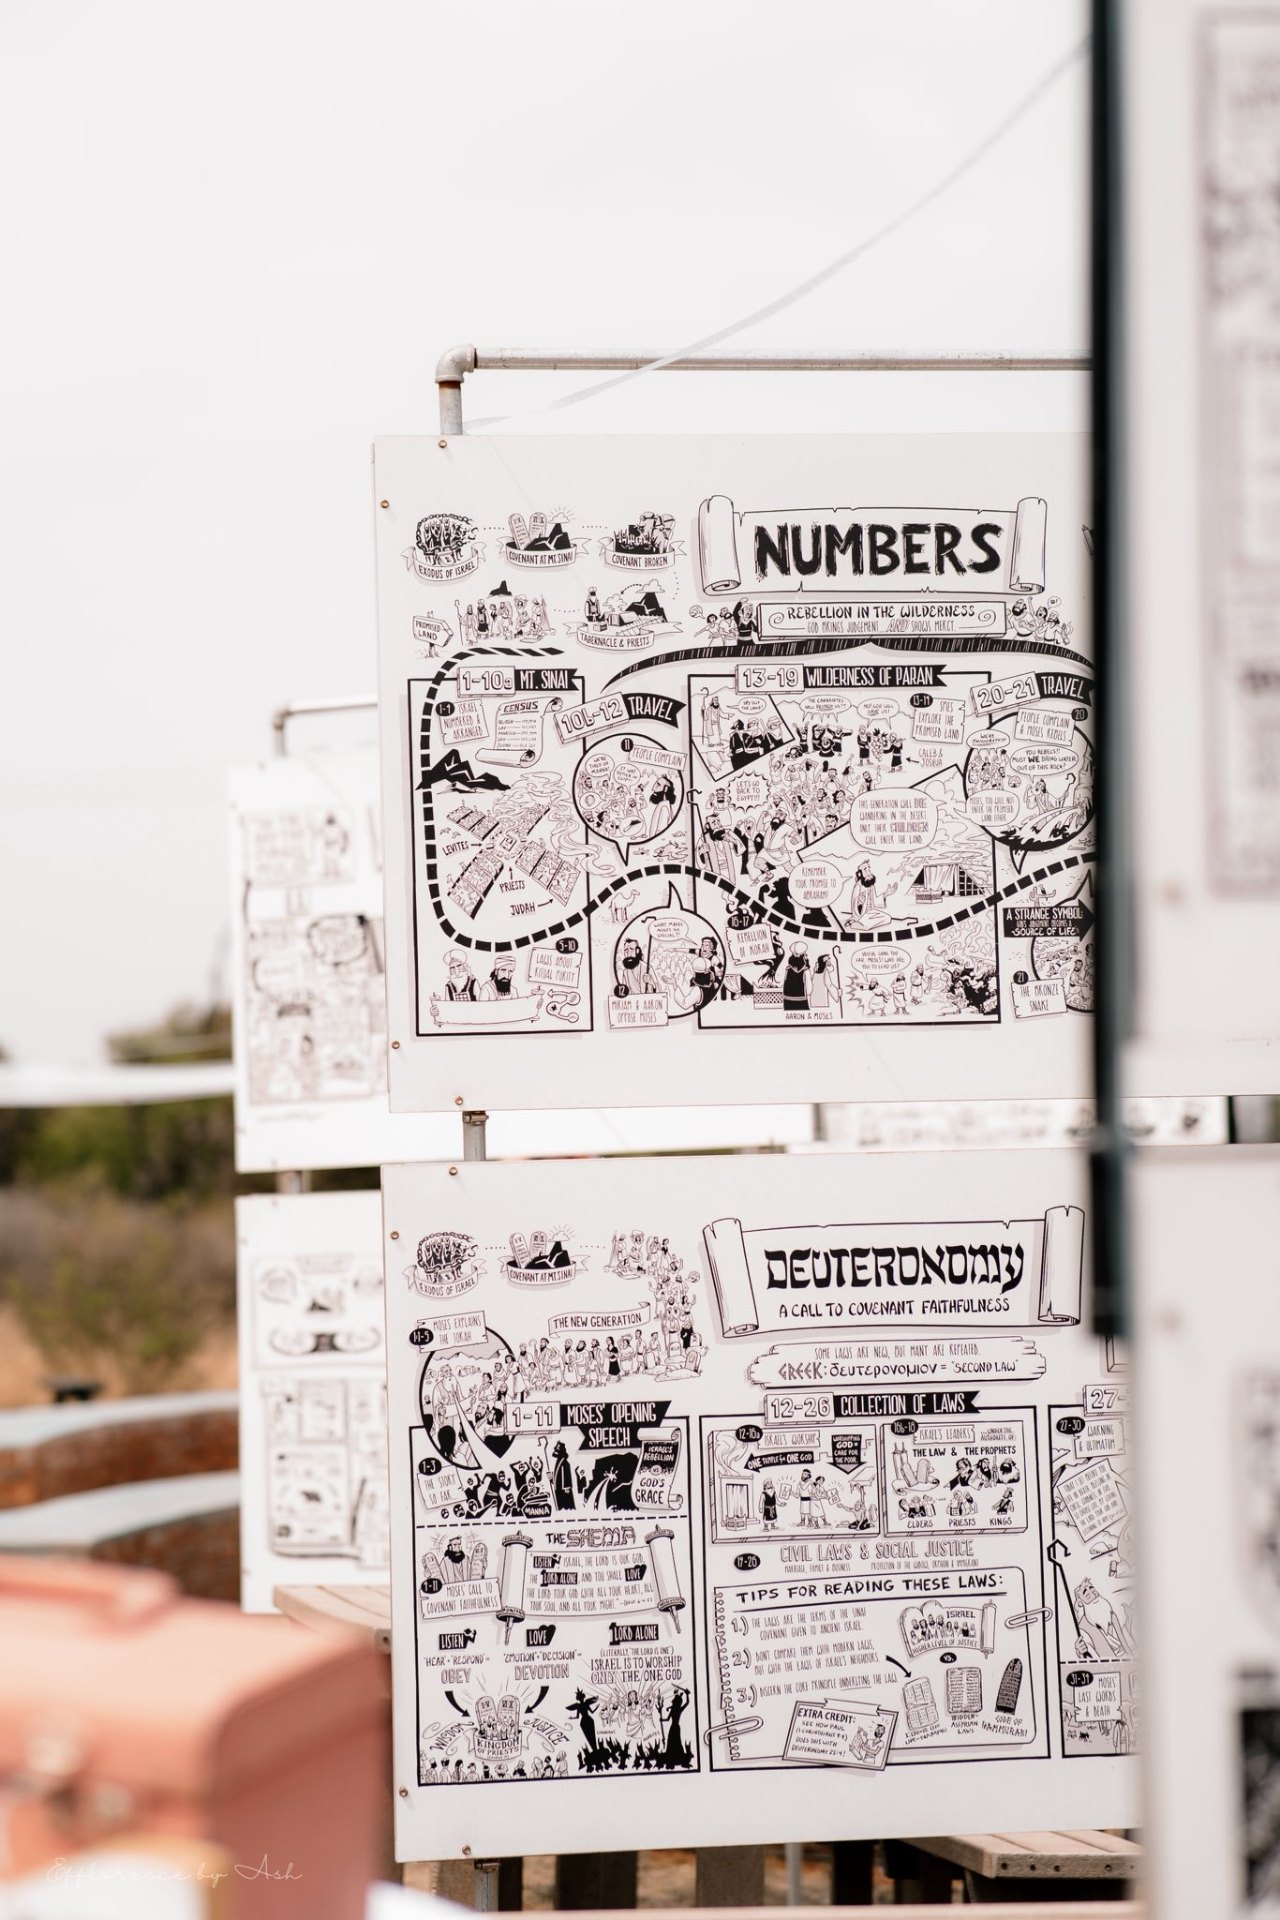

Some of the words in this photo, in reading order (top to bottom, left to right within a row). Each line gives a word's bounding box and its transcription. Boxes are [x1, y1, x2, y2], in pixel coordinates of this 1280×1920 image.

[509, 552, 538, 564] COVENANT
[540, 554, 547, 564] AT
[558, 552, 573, 562] SINAI
[755, 520, 1004, 582] NUMBERS
[611, 555, 640, 566] COVENANT
[644, 555, 668, 566] BROKEN
[419, 566, 444, 578] EXODUS
[446, 567, 454, 578] OF
[455, 562, 476, 575] ISRAEL
[787, 606, 852, 620] REBELLION
[856, 606, 870, 618] IN
[872, 606, 896, 618] THE
[900, 604, 976, 618] WILDERNESS
[415, 619, 441, 633] PROMISED
[418, 630, 438, 641] LAND
[580, 632, 618, 648] TABERNACLE
[627, 634, 650, 648] PRIESTS
[541, 670, 568, 690] SINAI
[743, 667, 798, 688] 13-19
[806, 668, 874, 686] WILDERNESS
[880, 667, 892, 686] OF
[896, 666, 933, 686] PARAN
[978, 676, 1036, 708] 20-21
[1041, 676, 1084, 700] TRAVEL
[504, 701, 538, 713] CENSUS
[628, 696, 673, 720] TRAVEL
[442, 840, 469, 856] LEVITES
[500, 880, 526, 892] PRIESTS
[510, 902, 536, 916] JUDAH
[1006, 910, 1012, 920] A
[1014, 908, 1050, 920] STRANGE
[1046, 928, 1056, 936] OF
[510, 1270, 539, 1282] COVENANT
[540, 1273, 547, 1282] AT
[558, 1269, 572, 1280] SINAI
[420, 1282, 444, 1296] EXODUS
[446, 1283, 454, 1294] OF
[456, 1279, 476, 1292] ISRAEL
[779, 1305, 788, 1318] A
[792, 1303, 822, 1317] CALL
[826, 1303, 842, 1316] TO
[848, 1300, 914, 1316] COVENANT
[922, 1298, 1010, 1314] FAITHFULNESS
[553, 1318, 569, 1330] THE
[570, 1316, 588, 1328] NEW
[590, 1313, 642, 1328] GENERATION
[835, 1346, 852, 1359] LAWS
[857, 1346, 869, 1358] ARE
[932, 1344, 944, 1357] ARE
[771, 1398, 831, 1418] 12-26
[840, 1395, 906, 1416] COLLECTION
[913, 1394, 926, 1414] OF
[934, 1393, 966, 1412] LAWS
[512, 1406, 553, 1428] 1-11
[612, 1402, 656, 1422] OPENING
[588, 1426, 630, 1448] SPEECH
[912, 1448, 927, 1458] THE
[929, 1448, 946, 1456] LAW
[965, 1446, 980, 1456] THE
[980, 1445, 1016, 1455] PROPHETS
[423, 1461, 436, 1473] 1-3
[748, 1458, 762, 1469] ONE
[786, 1454, 800, 1464] ONE
[800, 1453, 812, 1462] GOD
[635, 1490, 664, 1504] GRACE
[908, 1520, 934, 1528] ELDERS
[990, 1518, 1012, 1526] KINGS
[546, 1532, 566, 1545] THE
[566, 1526, 636, 1548] SHEMA
[780, 1545, 812, 1562] CIVIL
[816, 1544, 852, 1562] LAWS
[860, 1542, 870, 1560] &
[874, 1541, 918, 1559] SOCIAL
[925, 1539, 974, 1558] JUSTICE
[626, 1568, 641, 1580] LOVE
[736, 1588, 779, 1604] TIPS
[788, 1586, 818, 1600] FOR
[824, 1580, 894, 1596] READING
[902, 1576, 950, 1592] THESE
[958, 1574, 1004, 1589] LAWS:
[946, 1610, 976, 1618] ISRAEL
[528, 1630, 548, 1645] LOVE
[614, 1626, 633, 1642] LORD
[634, 1625, 658, 1640] ALONE
[440, 1634, 464, 1650] LISTEN
[514, 1664, 570, 1680] DEVOTION
[590, 1658, 622, 1672] ISRAEL
[624, 1658, 632, 1670] IS
[632, 1657, 644, 1670] TO
[645, 1656, 682, 1669] WORSHIP
[440, 1668, 472, 1684] OBEY
[590, 1670, 616, 1684] ONLY
[622, 1670, 640, 1682] THE
[643, 1670, 663, 1682] ONE
[665, 1669, 682, 1681] GOD
[798, 1708, 822, 1720] EXTRA
[996, 1716, 1011, 1724] CODE
[524, 1718, 570, 1746] JUSTICE
[982, 1720, 1028, 1737] HAMMURABI
[477, 1736, 520, 1748] KINGDOM
